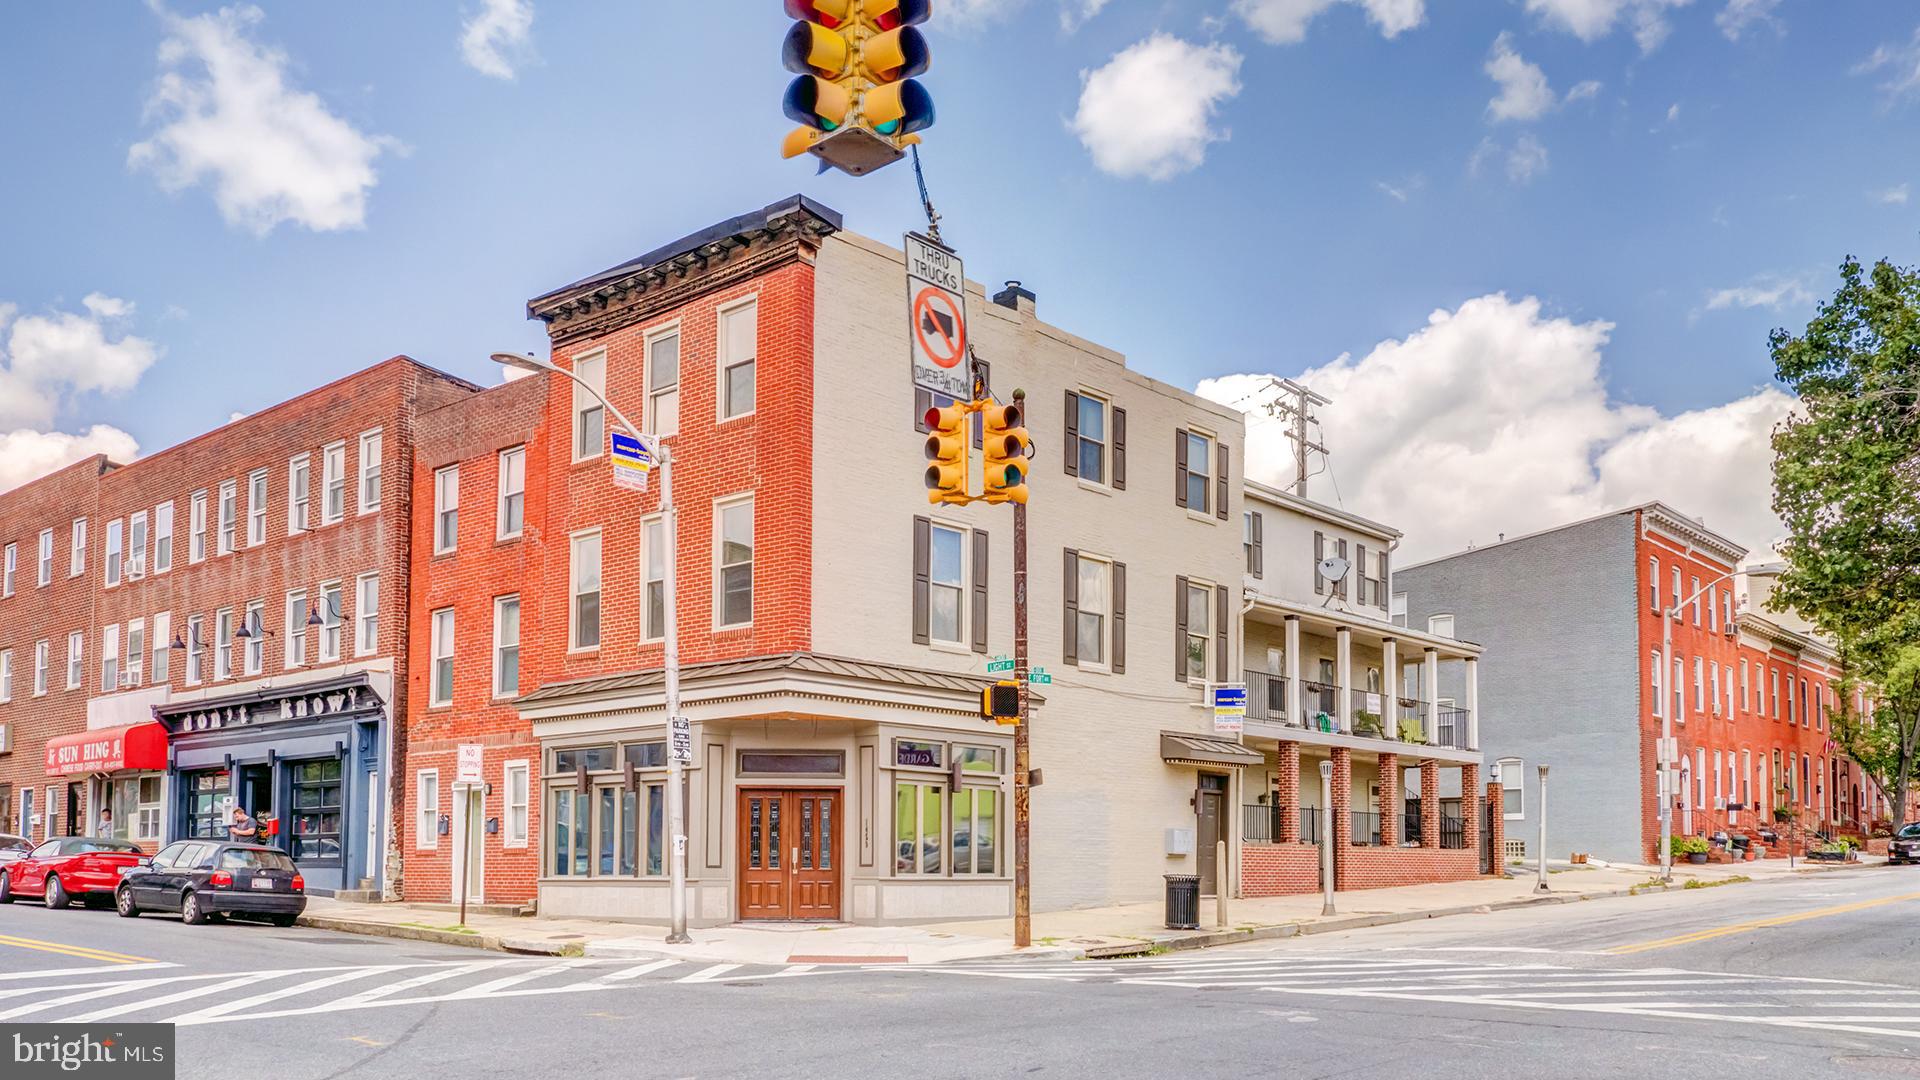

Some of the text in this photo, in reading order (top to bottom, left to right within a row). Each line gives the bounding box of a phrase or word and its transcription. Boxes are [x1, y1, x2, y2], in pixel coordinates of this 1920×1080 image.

[920, 245, 949, 270] THRU
[914, 259, 957, 290] TRUCKS
[915, 365, 939, 385] OVER
[990, 661, 1005, 672] LIGHT
[1033, 674, 1044, 683] FORT
[183, 687, 357, 732] don't know?
[58, 741, 109, 764] SUN HING
[466, 749, 475, 757] NO
